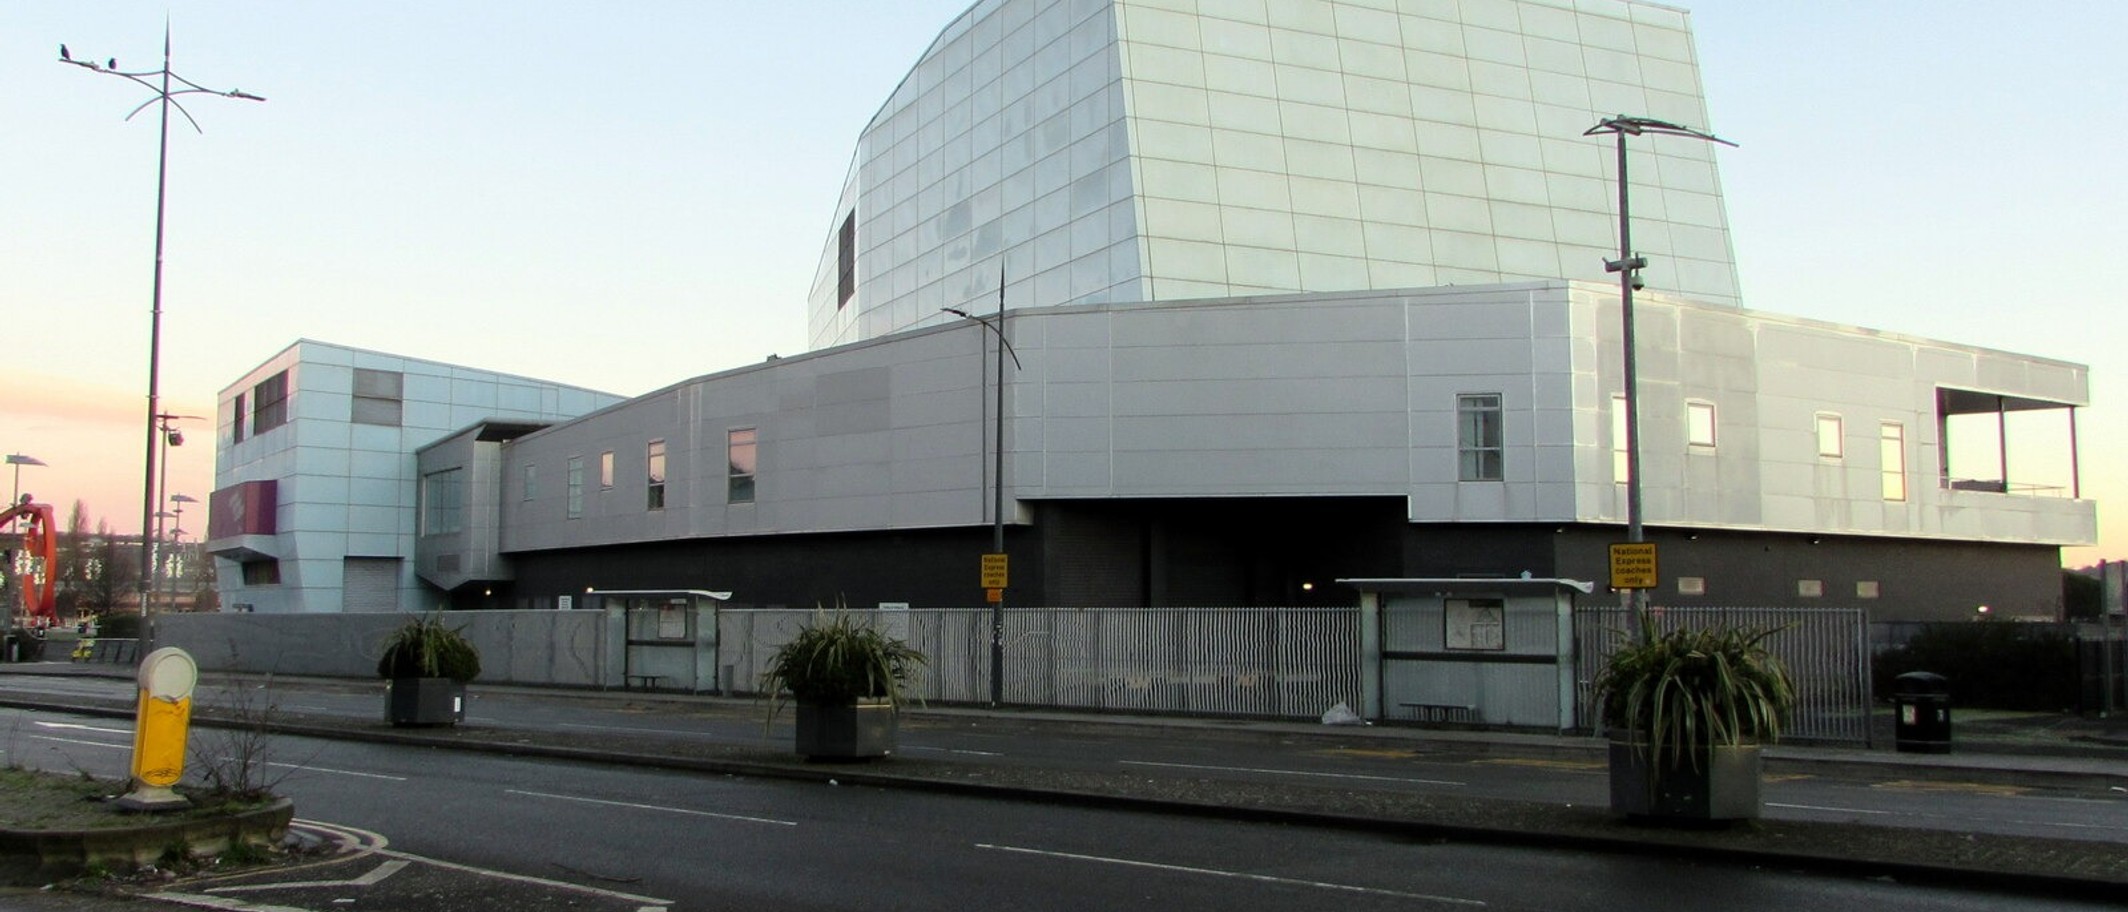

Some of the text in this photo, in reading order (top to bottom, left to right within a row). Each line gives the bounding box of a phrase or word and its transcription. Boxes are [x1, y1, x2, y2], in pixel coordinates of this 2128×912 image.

[1613, 547, 1652, 555] National
[1615, 557, 1652, 565] Express
[1615, 567, 1652, 575] coaches
[1624, 576, 1643, 584] only
